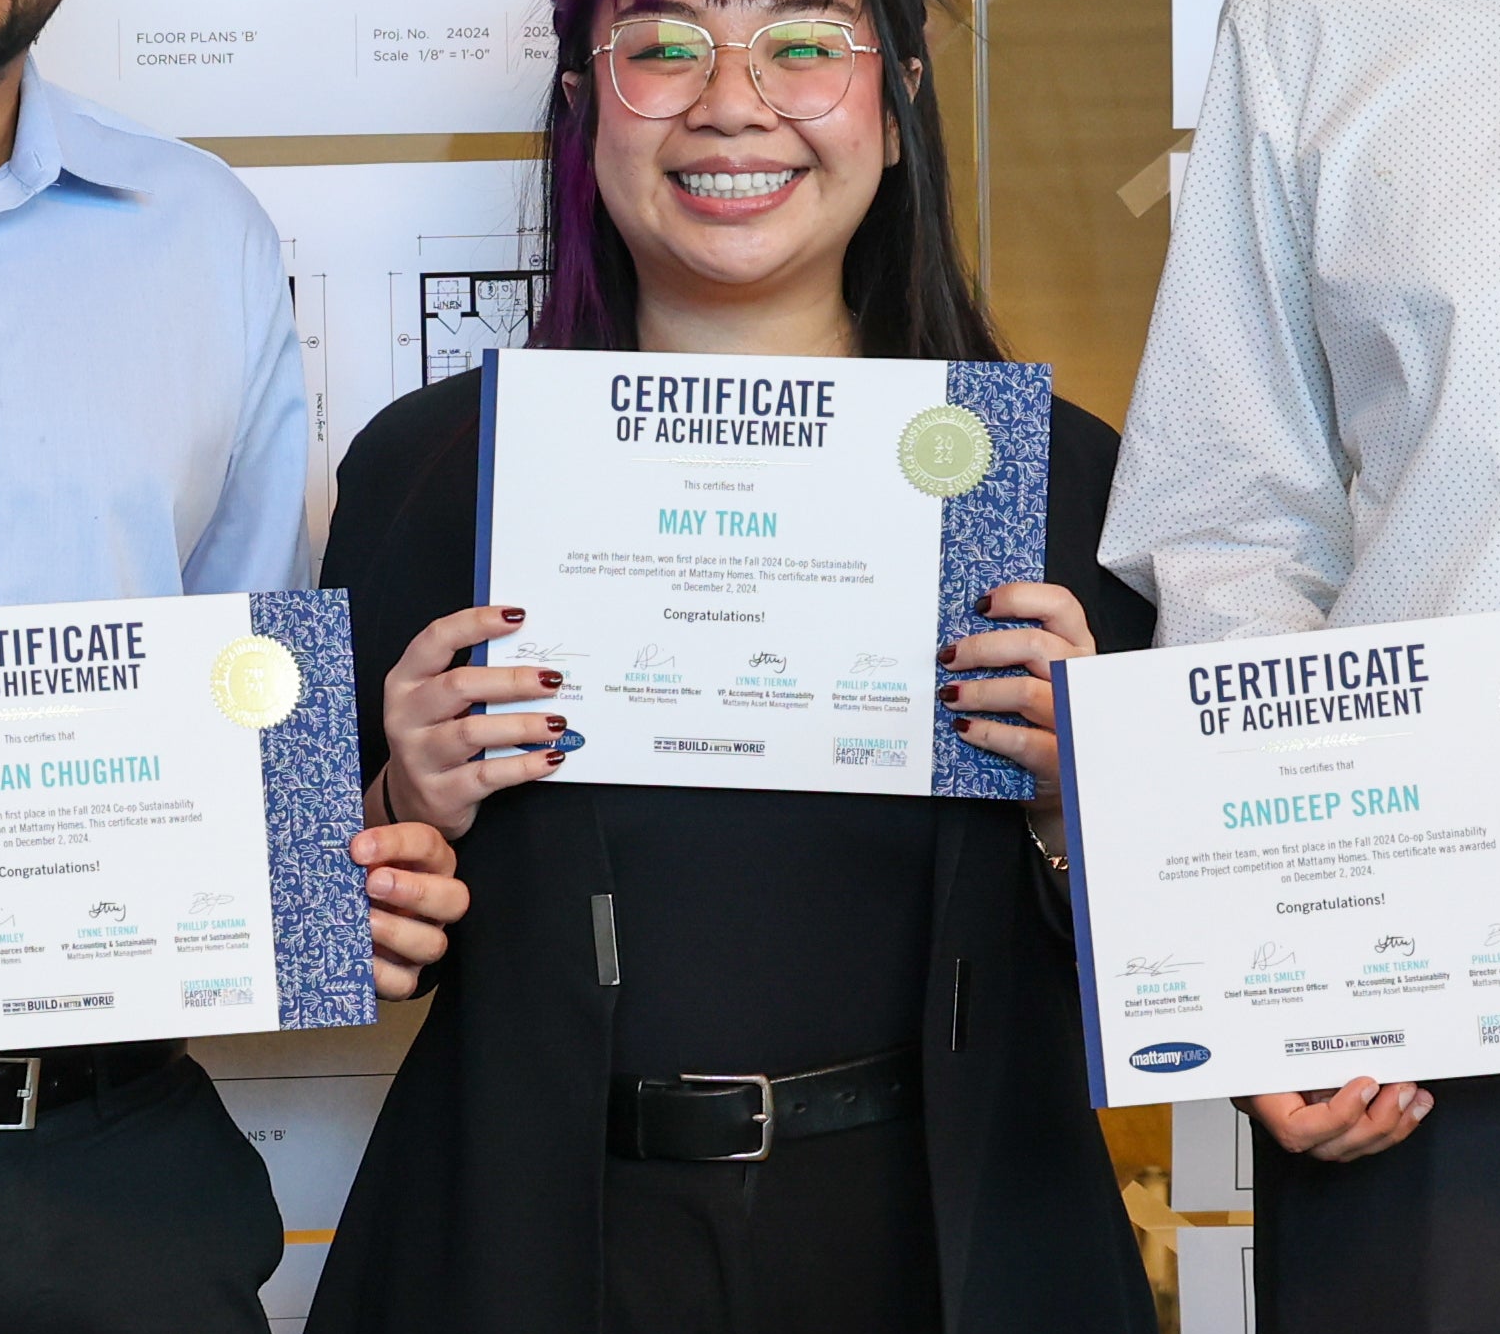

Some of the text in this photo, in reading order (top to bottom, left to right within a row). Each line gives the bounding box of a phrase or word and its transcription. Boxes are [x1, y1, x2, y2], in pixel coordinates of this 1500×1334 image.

[136, 31, 258, 45] FLOOR PLANS 'B'
[373, 27, 490, 42] Proj. No. 24024
[136, 53, 234, 66] CORNER UNIT
[373, 50, 409, 63] Scale
[611, 374, 835, 419] CERTIFICATE
[616, 416, 828, 448] OF ACHIEVEMENT
[659, 508, 777, 538] MAY TRAN
[663, 608, 765, 623] Congratulations!
[1189, 643, 1429, 706] CERTIFICATE
[1199, 687, 1424, 736] OF ACHIEVEMENT
[41, 755, 161, 788] CHUGHTAI
[1222, 784, 1420, 829] SANDEEP SRAN
[1276, 893, 1386, 915] Congratulations!
